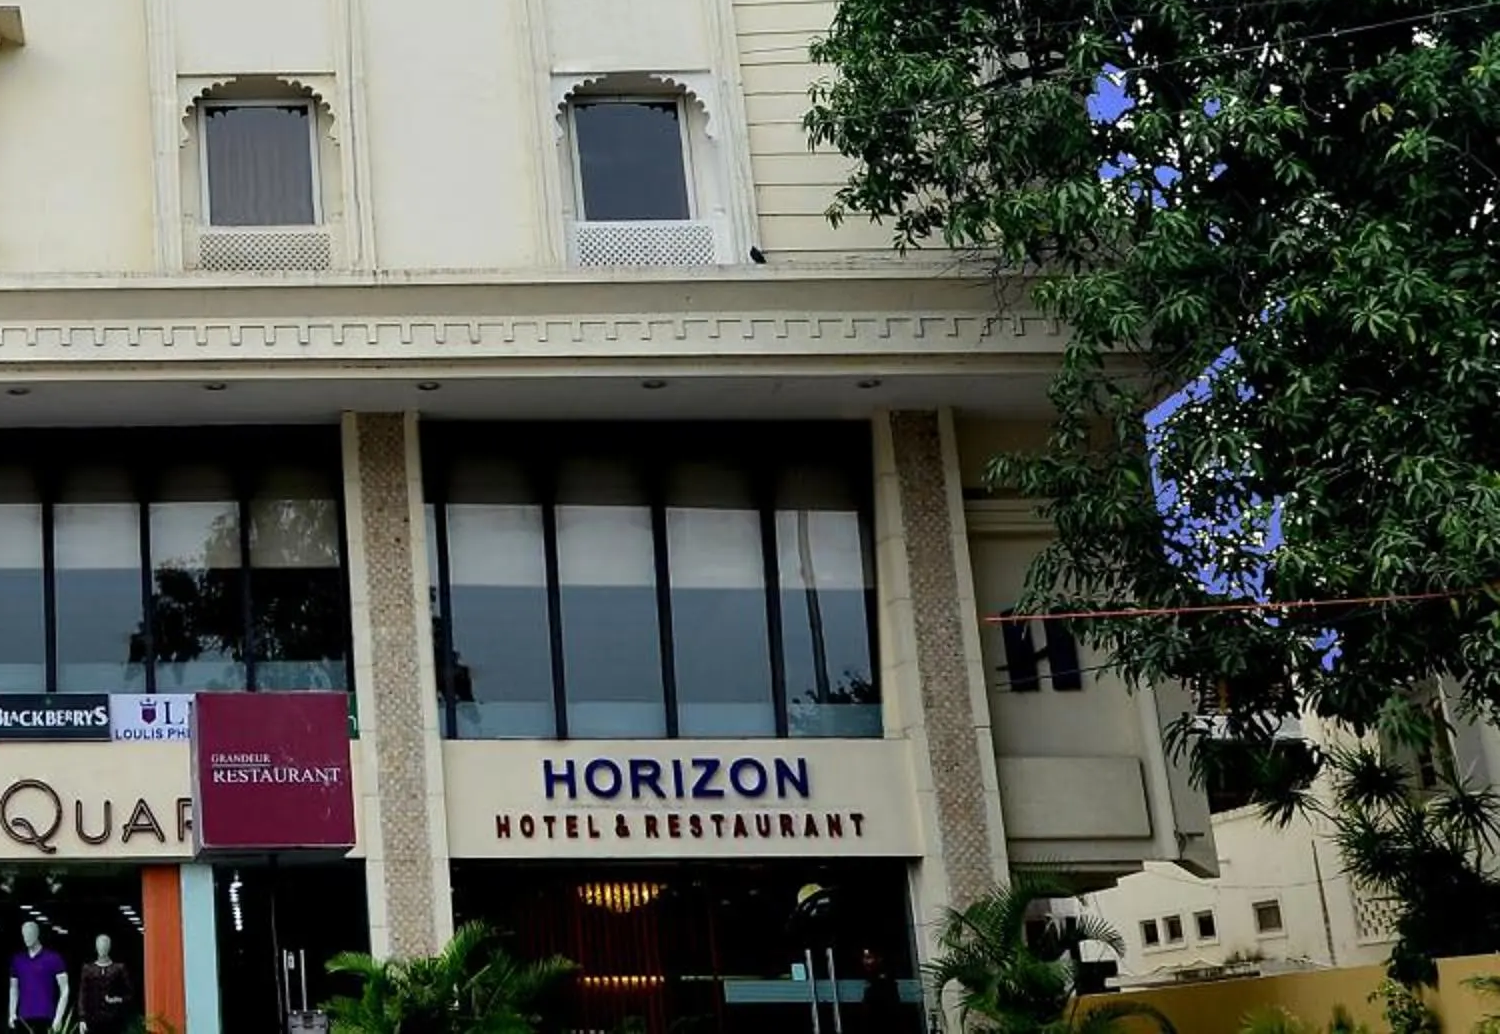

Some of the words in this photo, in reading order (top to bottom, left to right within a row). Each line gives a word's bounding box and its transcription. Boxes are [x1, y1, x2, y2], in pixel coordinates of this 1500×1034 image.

[211, 753, 271, 763] GRANDEUR
[213, 767, 341, 784] RESTAURANT
[543, 757, 810, 800] HORIZON
[495, 814, 600, 839] HOTEL
[615, 813, 630, 839] &
[644, 813, 865, 839] RESTAURANT
